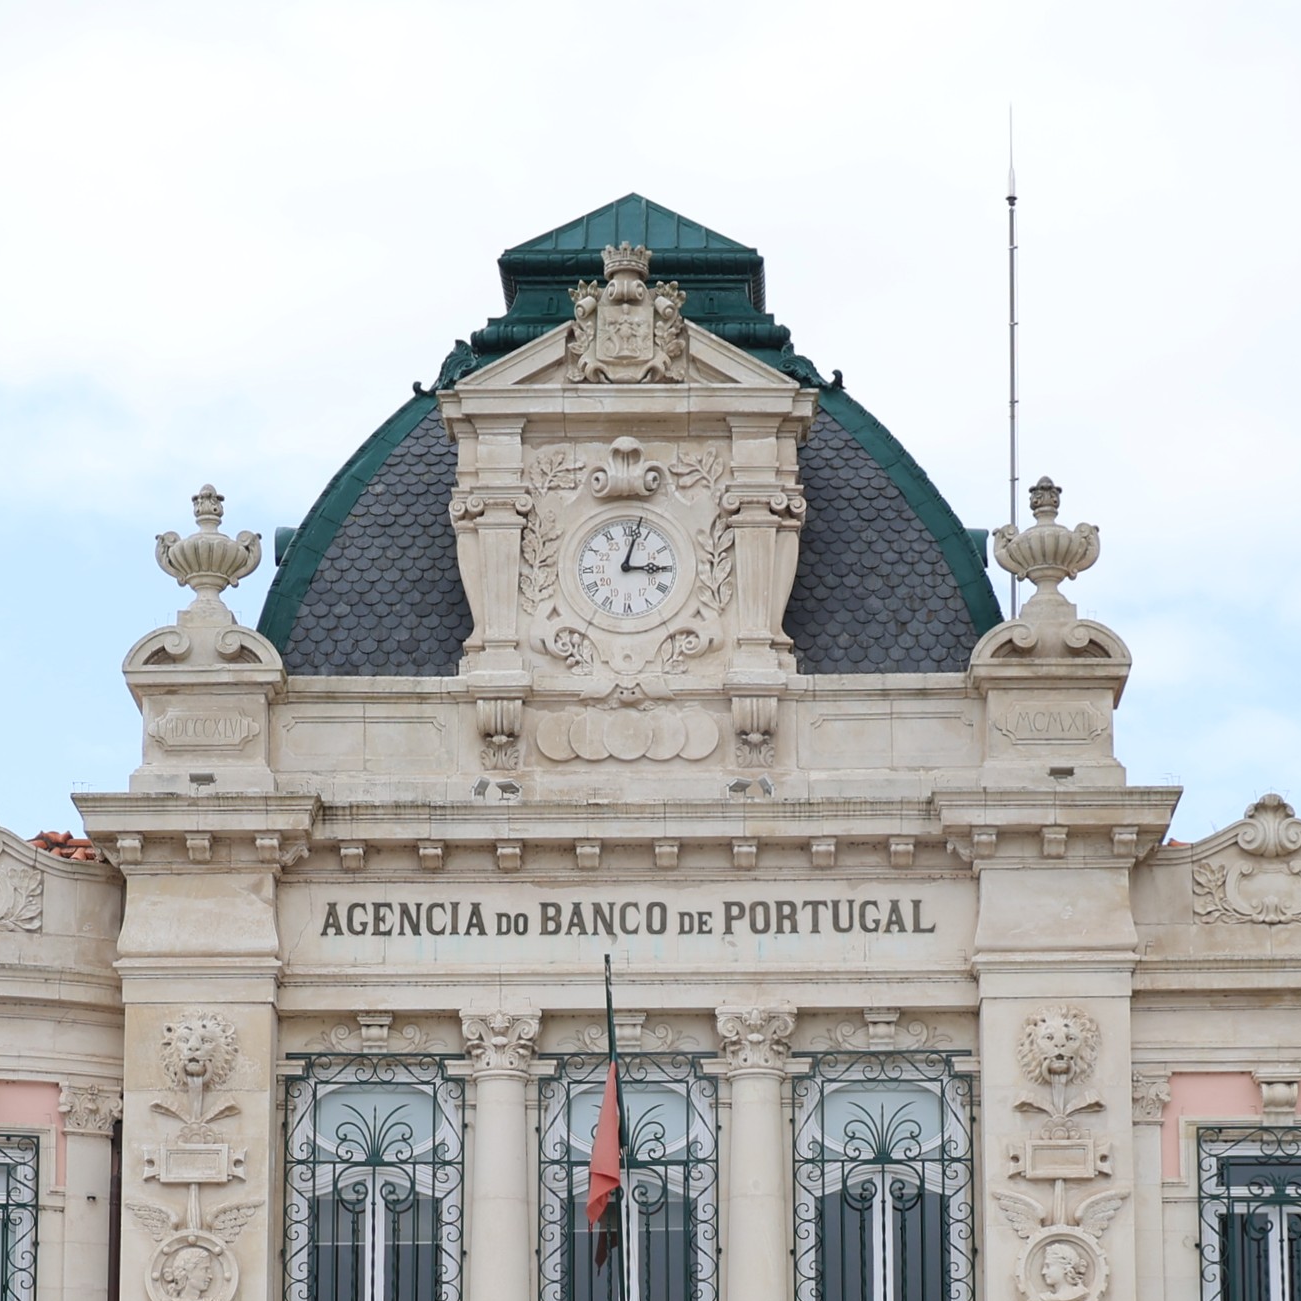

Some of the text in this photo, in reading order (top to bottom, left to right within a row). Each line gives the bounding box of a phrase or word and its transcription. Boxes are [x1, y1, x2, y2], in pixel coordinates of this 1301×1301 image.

[608, 543, 620, 551] 23
[599, 553, 610, 561] 22
[647, 552, 656, 561] 14
[595, 565, 605, 573] 21
[600, 578, 611, 586] 20
[648, 577, 656, 586] 16
[610, 588, 619, 597] 19
[638, 588, 647, 597] 17
[624, 593, 632, 601] 18
[320, 901, 488, 937] AGENCIA
[539, 901, 667, 936] BANCO
[723, 899, 937, 935] PORTUGAL
